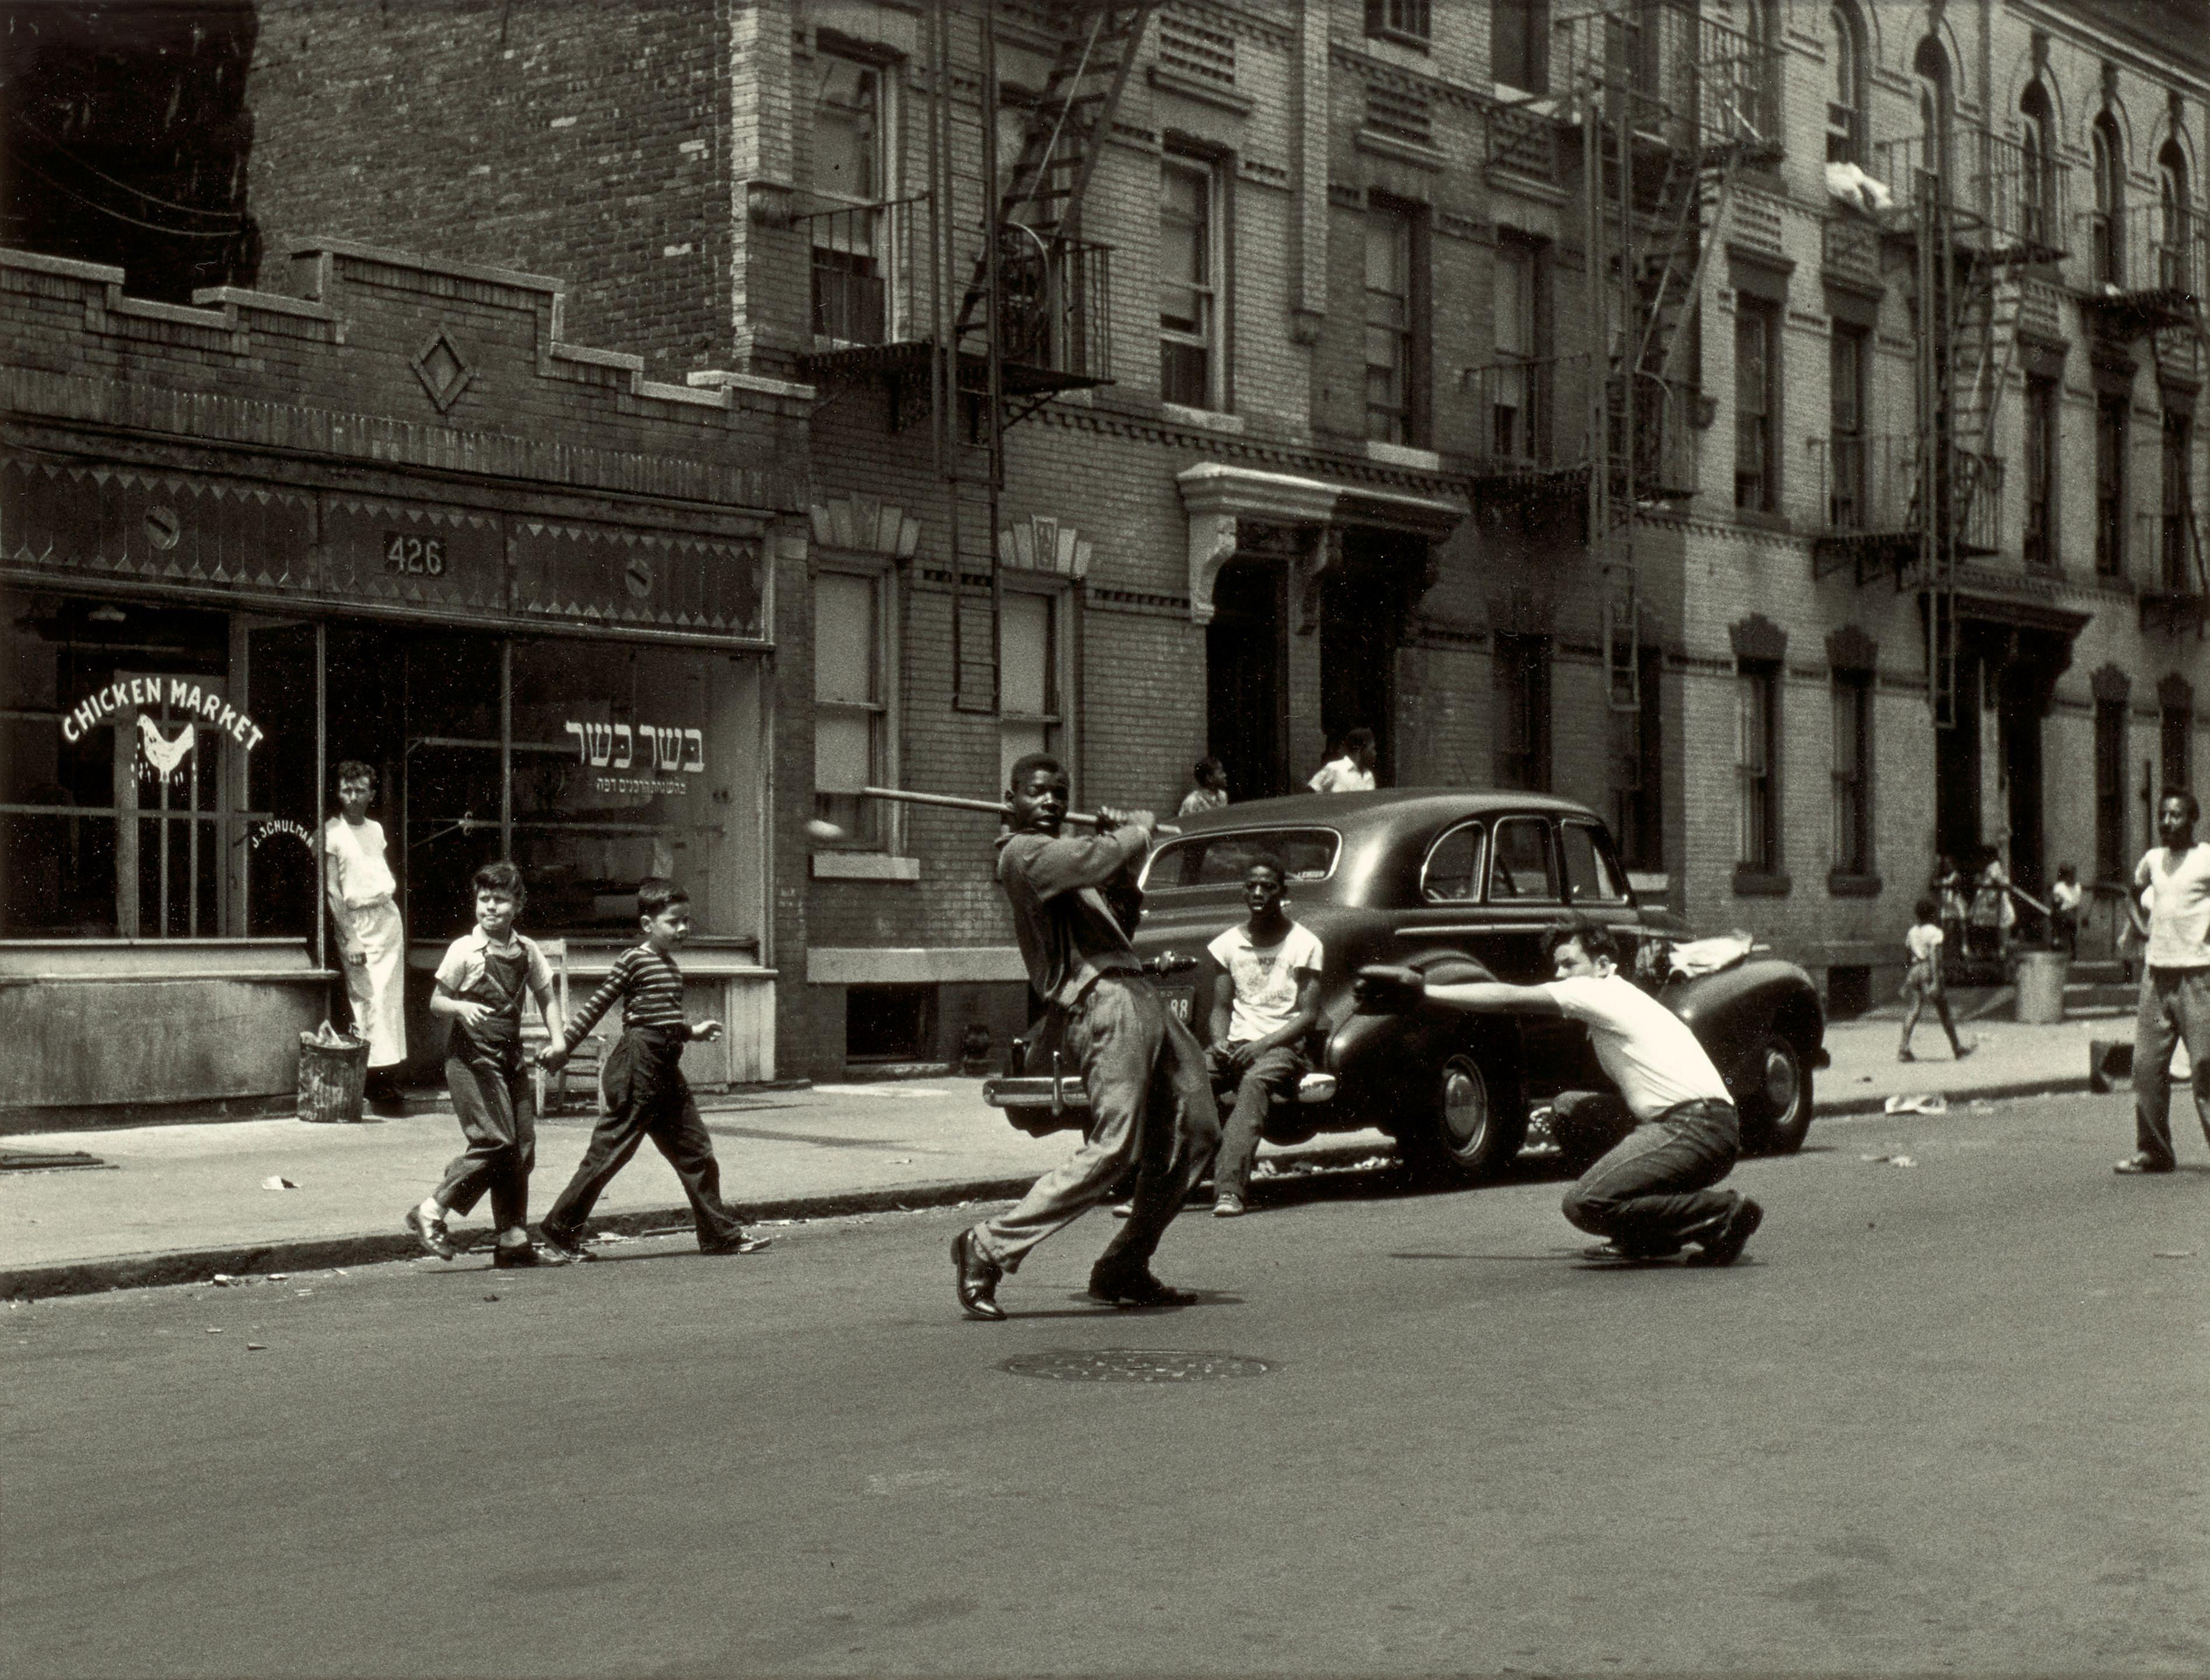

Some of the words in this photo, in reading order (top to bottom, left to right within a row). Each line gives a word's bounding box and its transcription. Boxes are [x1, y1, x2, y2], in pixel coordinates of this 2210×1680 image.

[387, 537, 442, 575] 426
[63, 677, 161, 742] CHICKEN
[170, 678, 264, 751] MARKET
[260, 820, 314, 848] SCHULMAN
